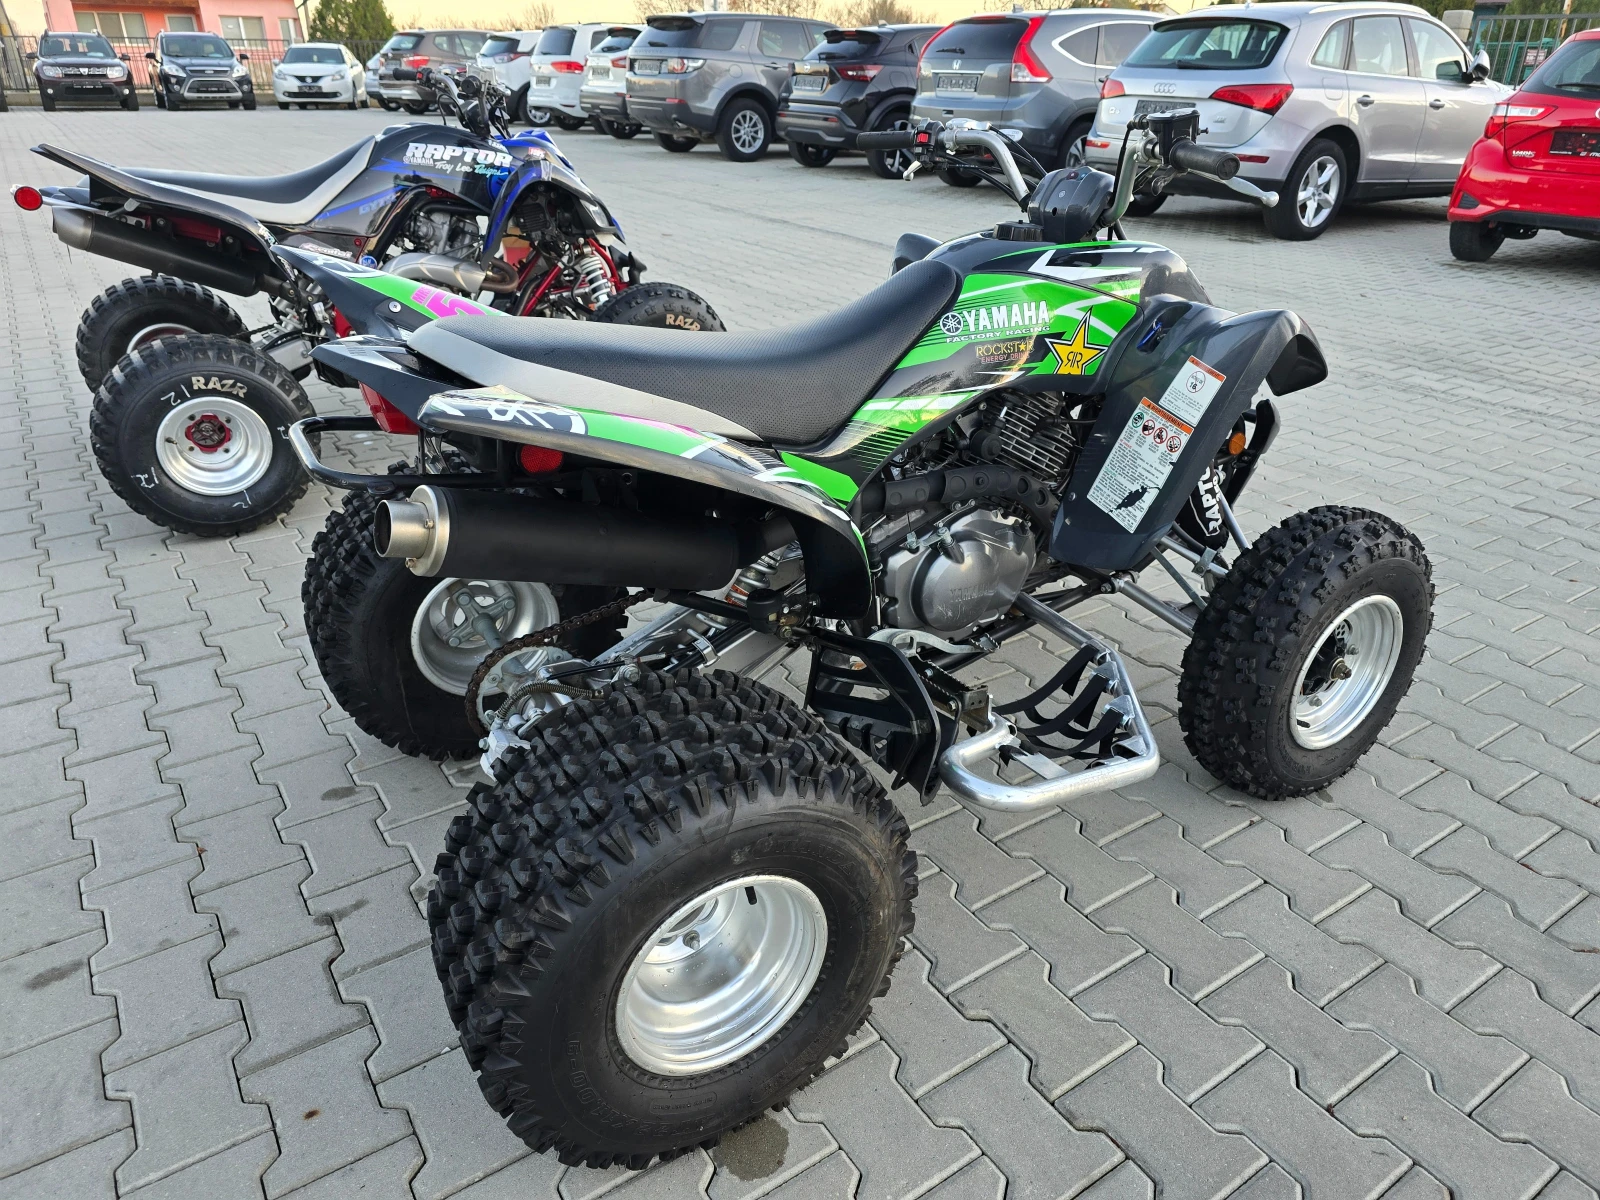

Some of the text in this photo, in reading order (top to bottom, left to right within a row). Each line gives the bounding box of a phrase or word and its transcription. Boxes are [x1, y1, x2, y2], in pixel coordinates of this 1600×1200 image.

[405, 142, 513, 168] RAPTOR
[410, 156, 434, 165] YAMAHA
[434, 161, 454, 174] Troy
[456, 158, 473, 172] Lee
[962, 300, 1050, 332] YAMAHA
[946, 325, 1051, 344] FACTORY RACING
[981, 353, 1008, 364] ENERGY
[191, 376, 248, 399] RAZR
